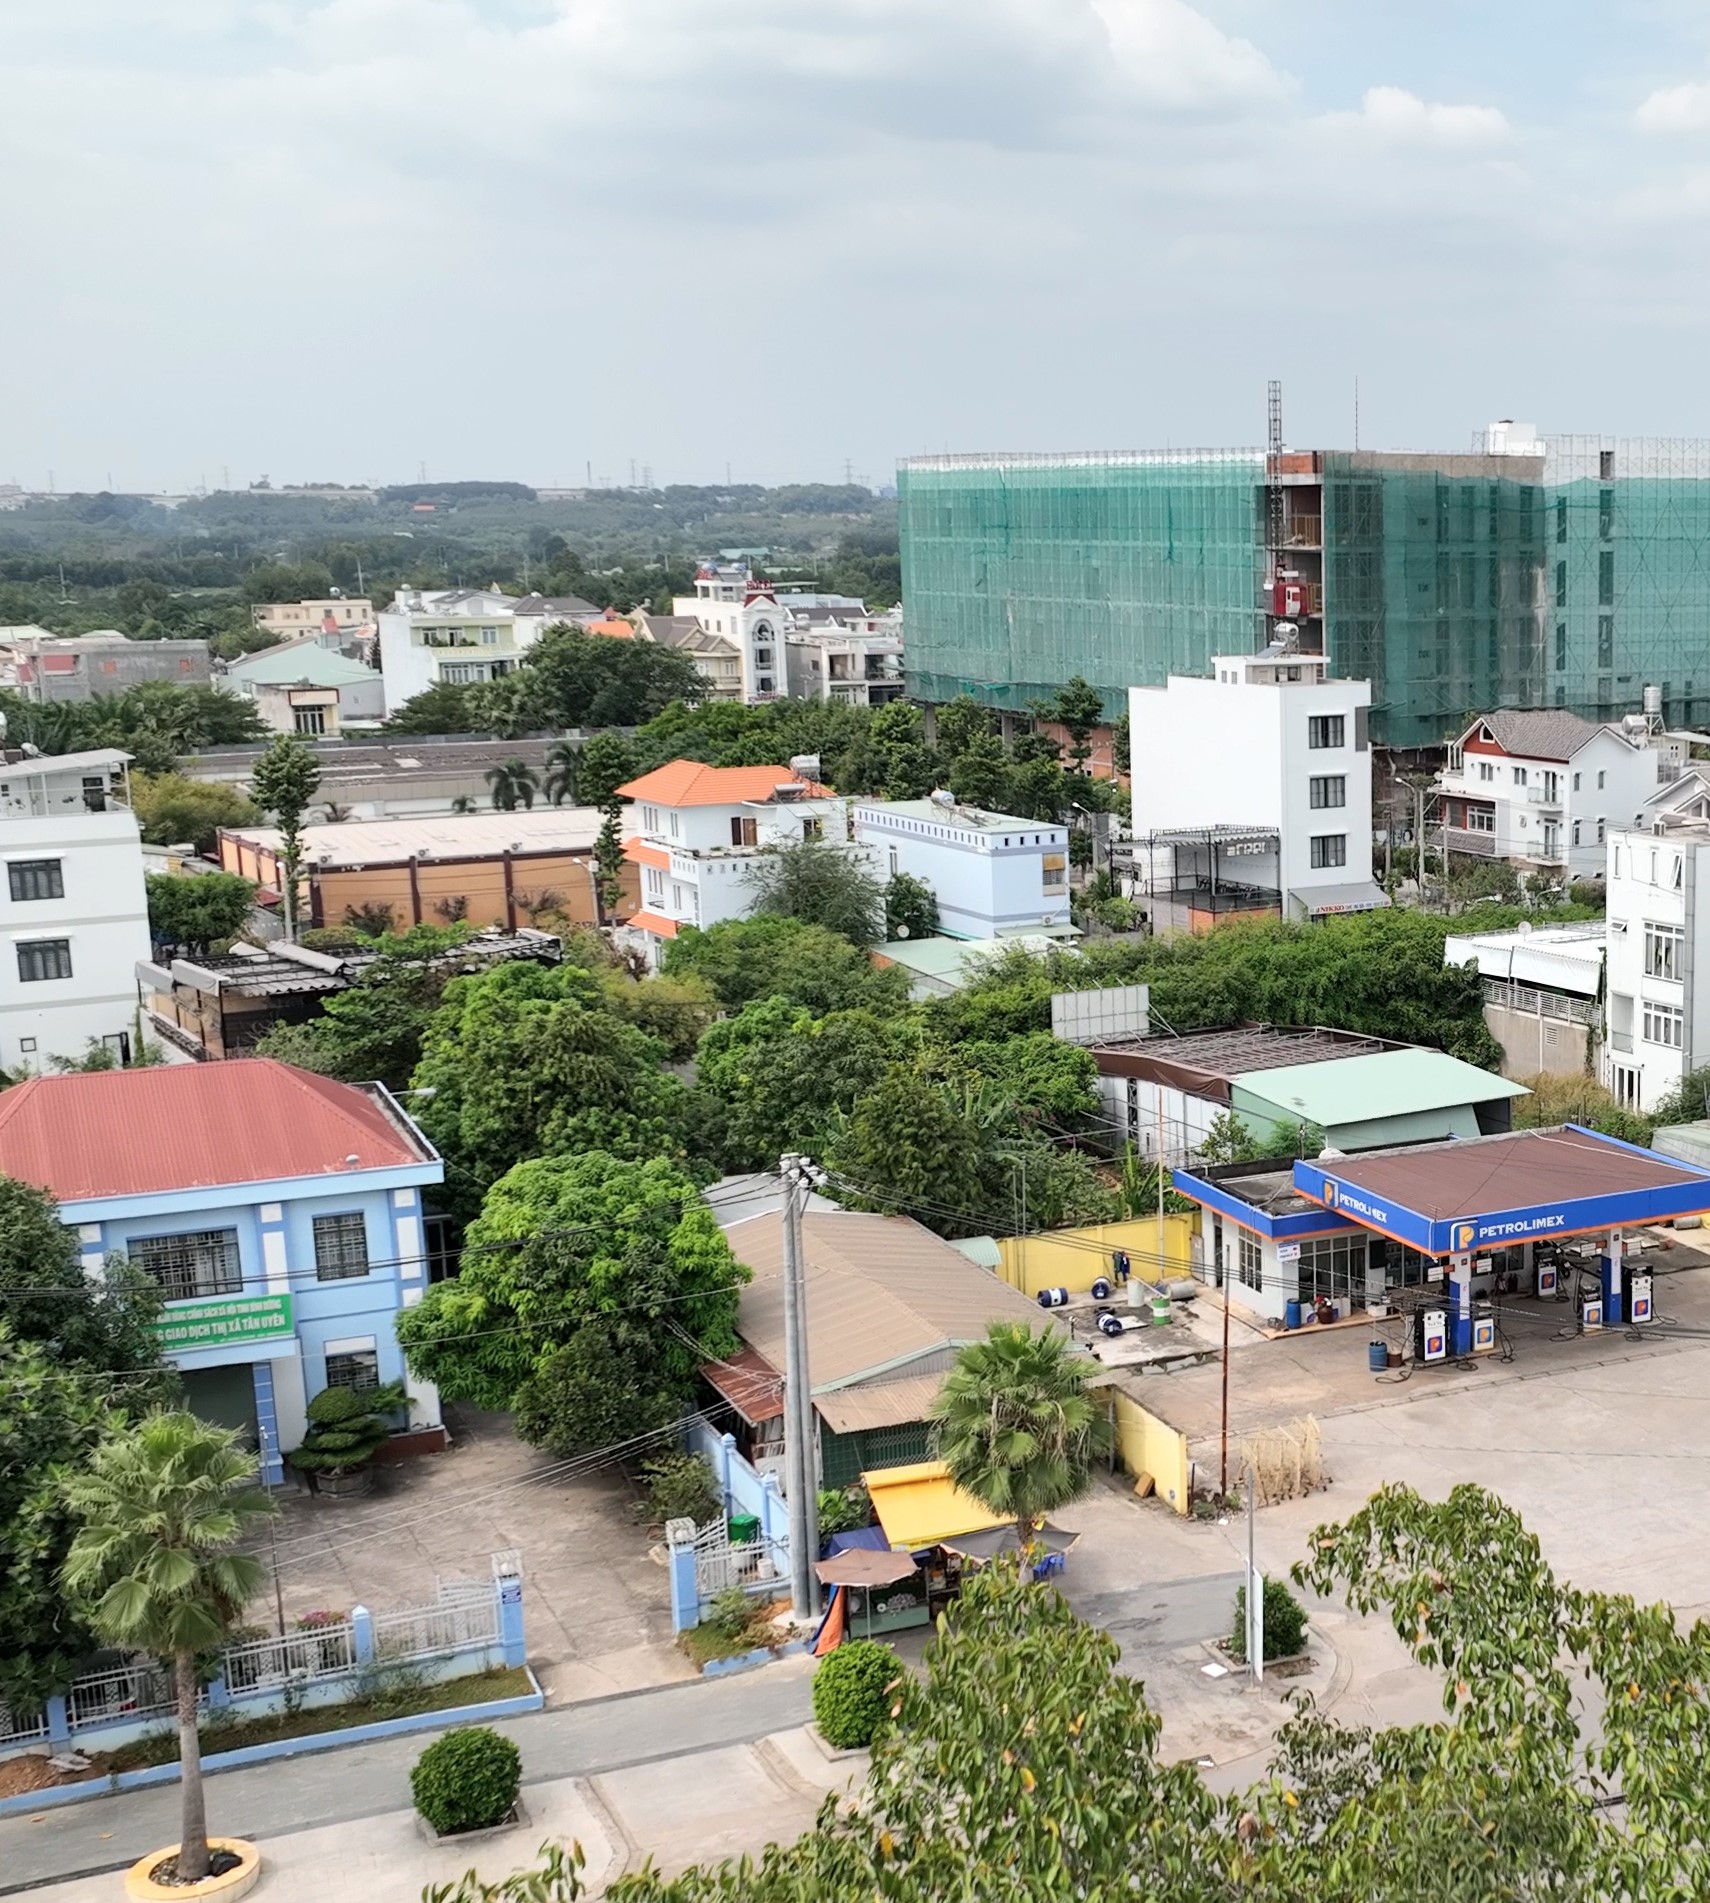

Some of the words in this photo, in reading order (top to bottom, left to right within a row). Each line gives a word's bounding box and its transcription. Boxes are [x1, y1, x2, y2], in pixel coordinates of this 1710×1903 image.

[1479, 1215, 1565, 1238] PETROLIMEX
[165, 1326, 187, 1341] GIAO
[189, 1324, 210, 1339] DỊCH
[211, 1322, 227, 1336] THỊ
[242, 1315, 260, 1330] TÂN
[262, 1313, 285, 1329] UYÊN
